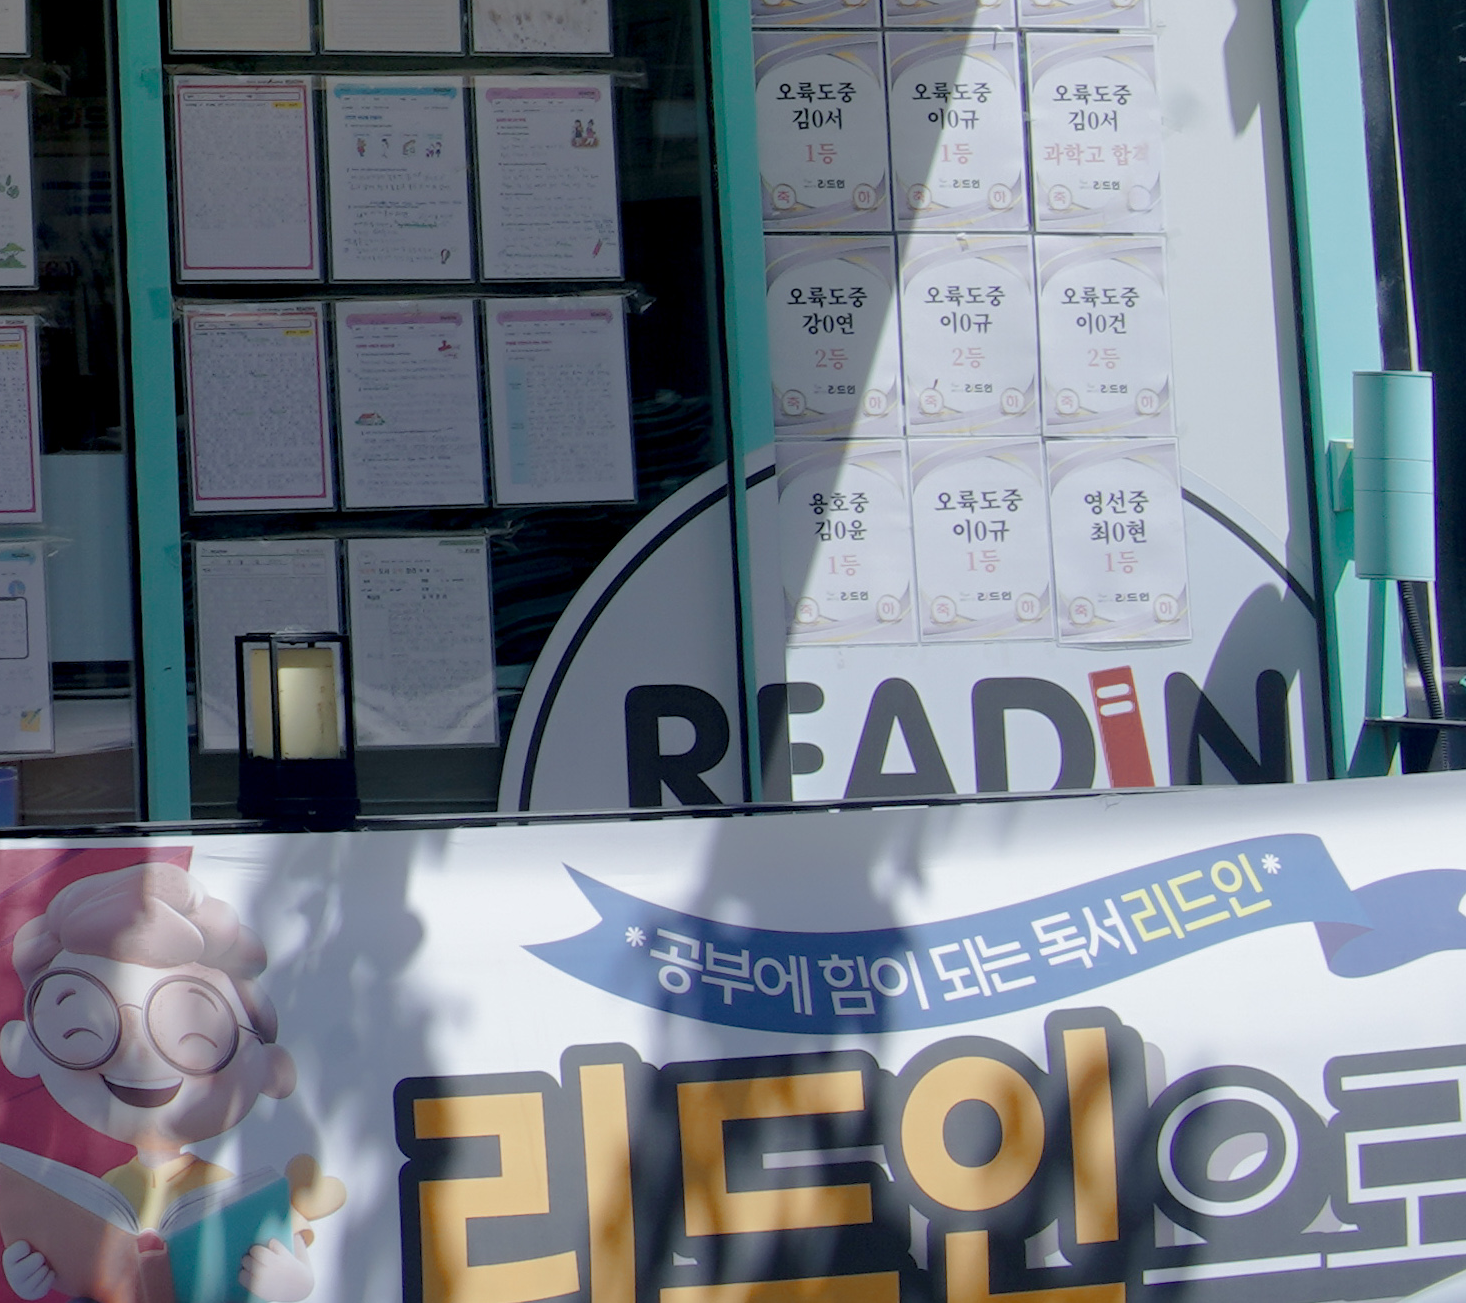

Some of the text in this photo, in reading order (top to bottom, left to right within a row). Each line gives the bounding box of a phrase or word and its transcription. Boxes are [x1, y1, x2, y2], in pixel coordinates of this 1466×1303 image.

[777, 82, 856, 104] 오륙도중
[912, 82, 991, 104] 오륙도중
[1053, 84, 1132, 106] 오륙도중
[806, 143, 837, 165] 1등
[941, 143, 973, 165] 1등
[1044, 144, 1104, 165] 과학고
[787, 287, 867, 308] 오륙도중
[924, 286, 1005, 308] 오륙도중
[1061, 287, 1140, 309] 오륙도중
[815, 348, 848, 370] 2등
[953, 347, 985, 369] 2등
[1088, 348, 1120, 370] 2등
[809, 493, 869, 515] 용호중
[935, 489, 1024, 513] 오륙도중
[1084, 490, 1149, 515] 영선중
[829, 555, 861, 577] 1등
[967, 550, 1001, 573] 1등
[1106, 551, 1138, 574] 1등
[649, 853, 1273, 1015] 공부에 힘이 되는 독서리드인
